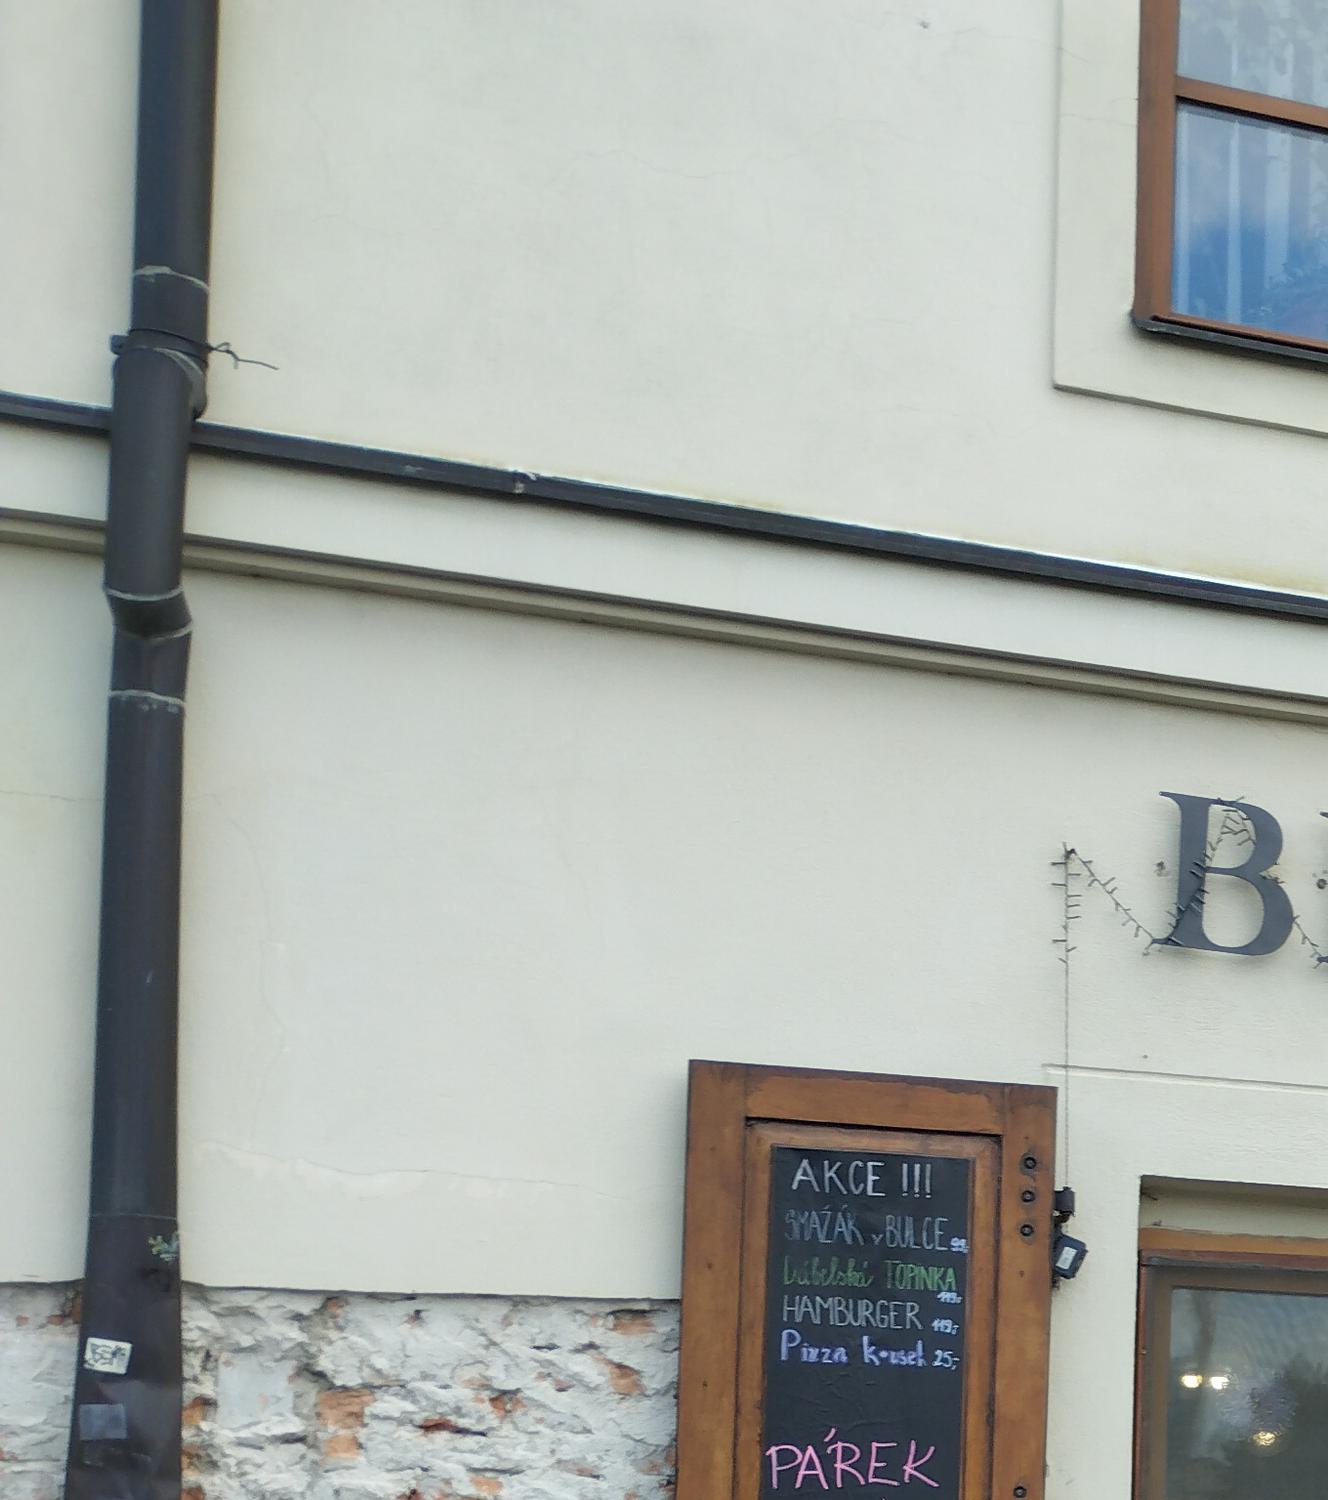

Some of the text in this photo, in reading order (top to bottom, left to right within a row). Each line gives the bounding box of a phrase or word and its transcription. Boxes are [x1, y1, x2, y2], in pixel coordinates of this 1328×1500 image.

[792, 1158, 933, 1198] AKCE !!!
[885, 1214, 949, 1251] BULCE
[883, 1259, 957, 1291] TOPINKA
[782, 1295, 924, 1330] HAMBURGER
[780, 1329, 848, 1364] Pizza
[765, 1428, 940, 1490] PÁREK
